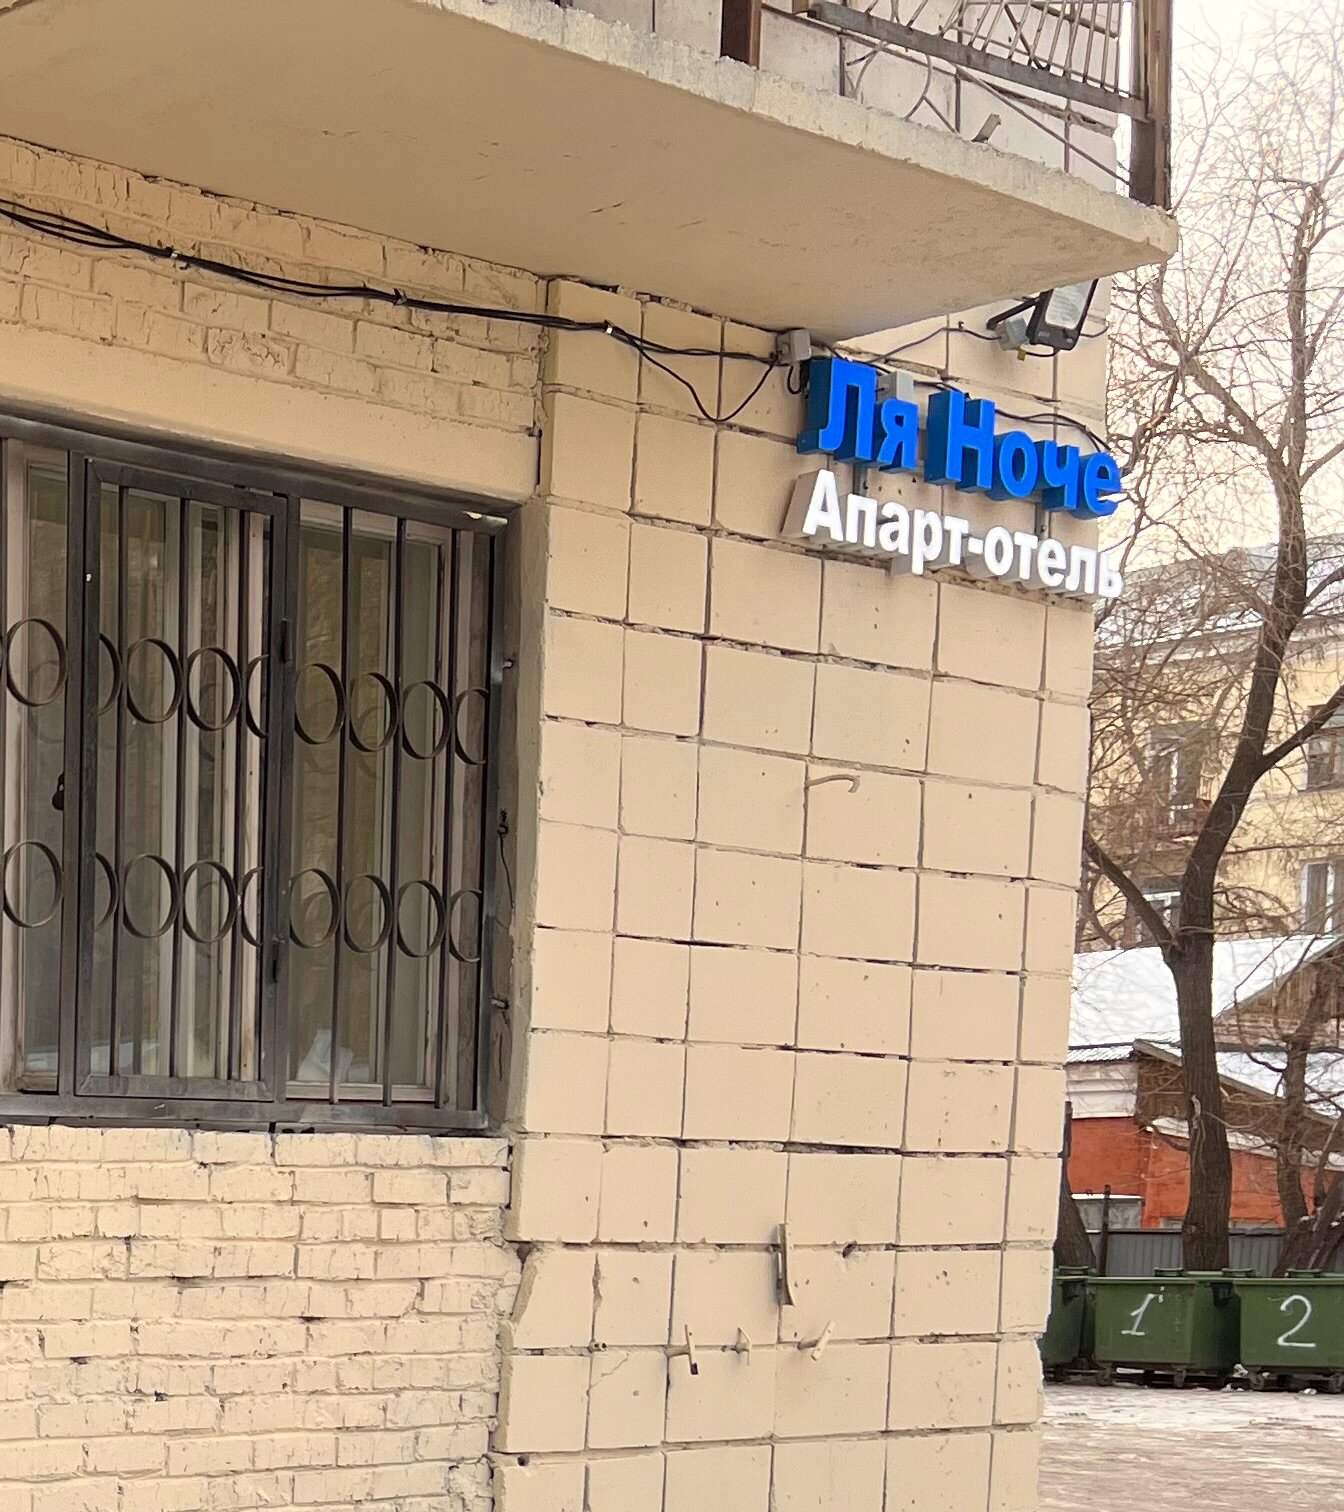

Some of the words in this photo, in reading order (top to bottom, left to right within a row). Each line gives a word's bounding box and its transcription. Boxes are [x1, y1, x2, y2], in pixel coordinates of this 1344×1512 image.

[808, 358, 919, 472] Ля
[936, 390, 1122, 518] Ноче
[802, 468, 1125, 599] Апарт-отель
[1277, 1295, 1316, 1347] 2
